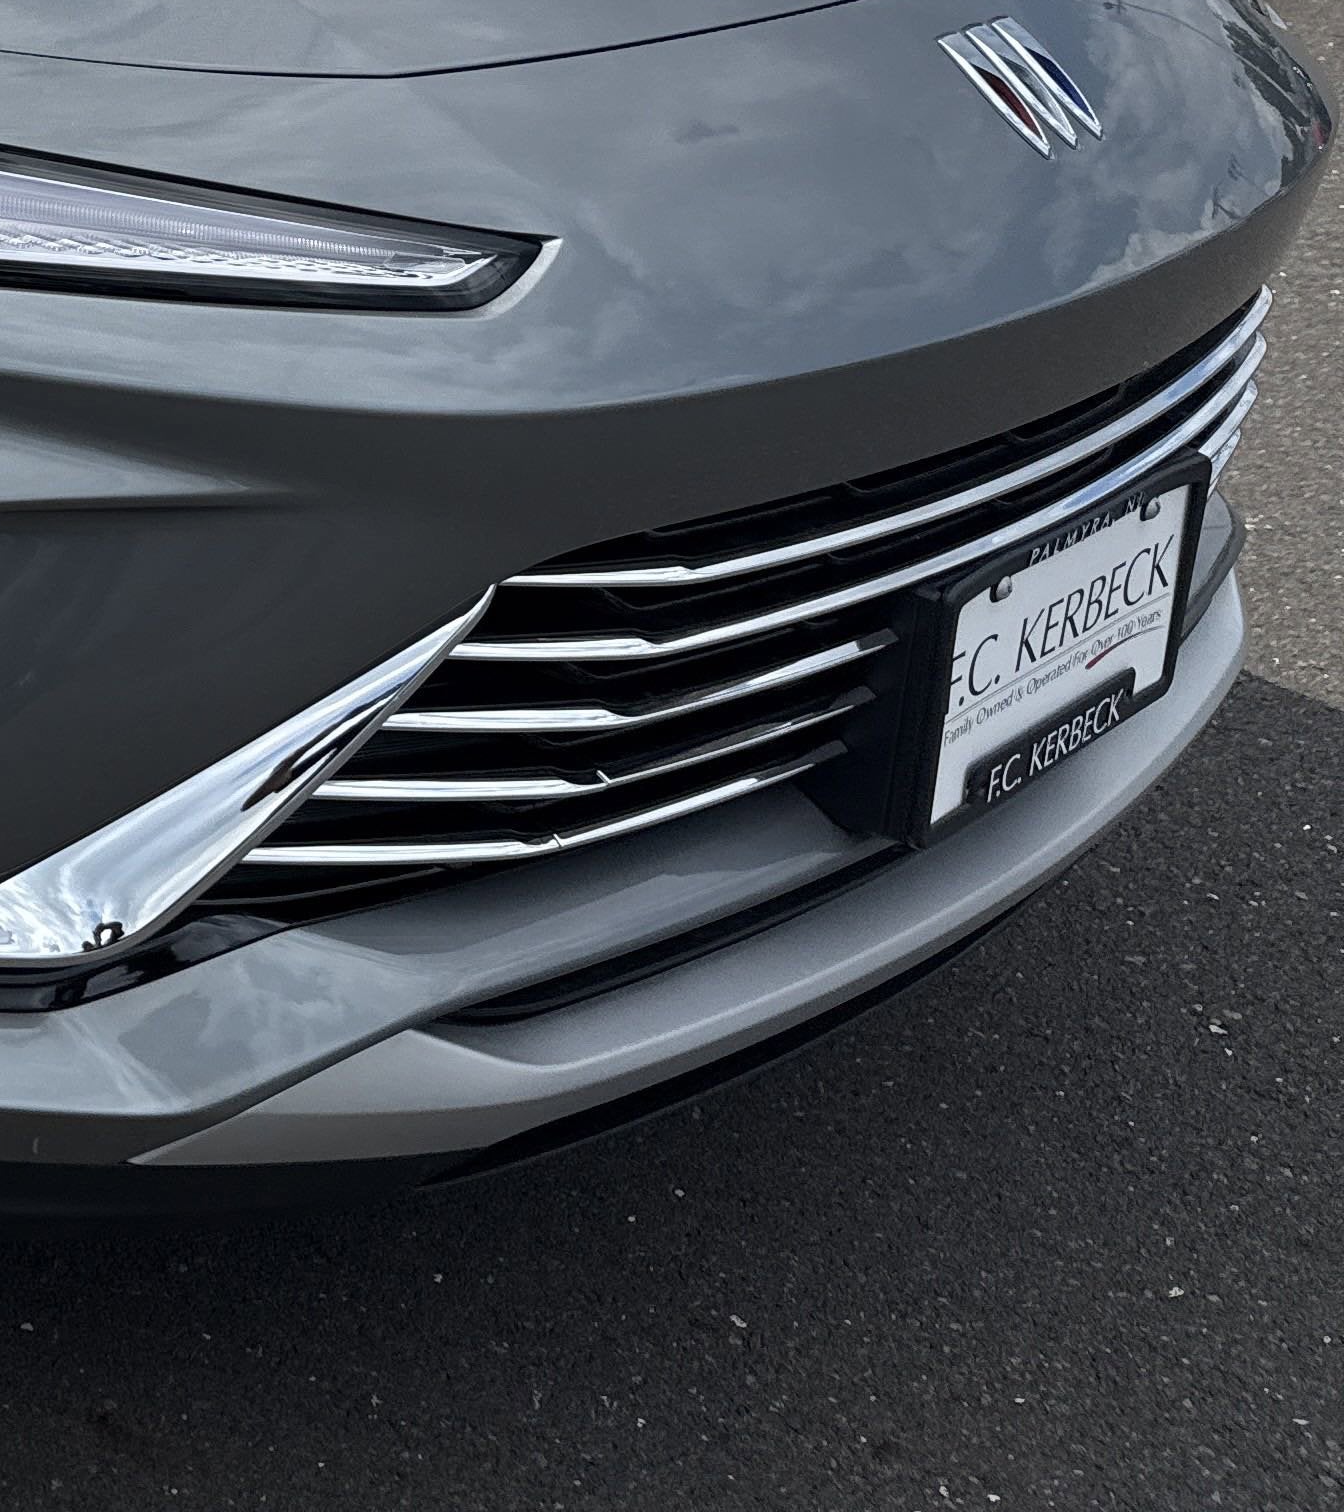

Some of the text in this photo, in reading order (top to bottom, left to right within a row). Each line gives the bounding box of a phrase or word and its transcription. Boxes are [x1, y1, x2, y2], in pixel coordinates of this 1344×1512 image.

[1014, 534, 1174, 673] KERBECK
[944, 716, 973, 747] Family
[976, 689, 1014, 725] Owned
[1026, 656, 1072, 694] Operated
[1072, 650, 1088, 668] For
[1091, 635, 1114, 655] Over
[1117, 619, 1135, 638] 100
[1137, 610, 1162, 630] Years
[987, 688, 1124, 803] F.C. KERBECK
